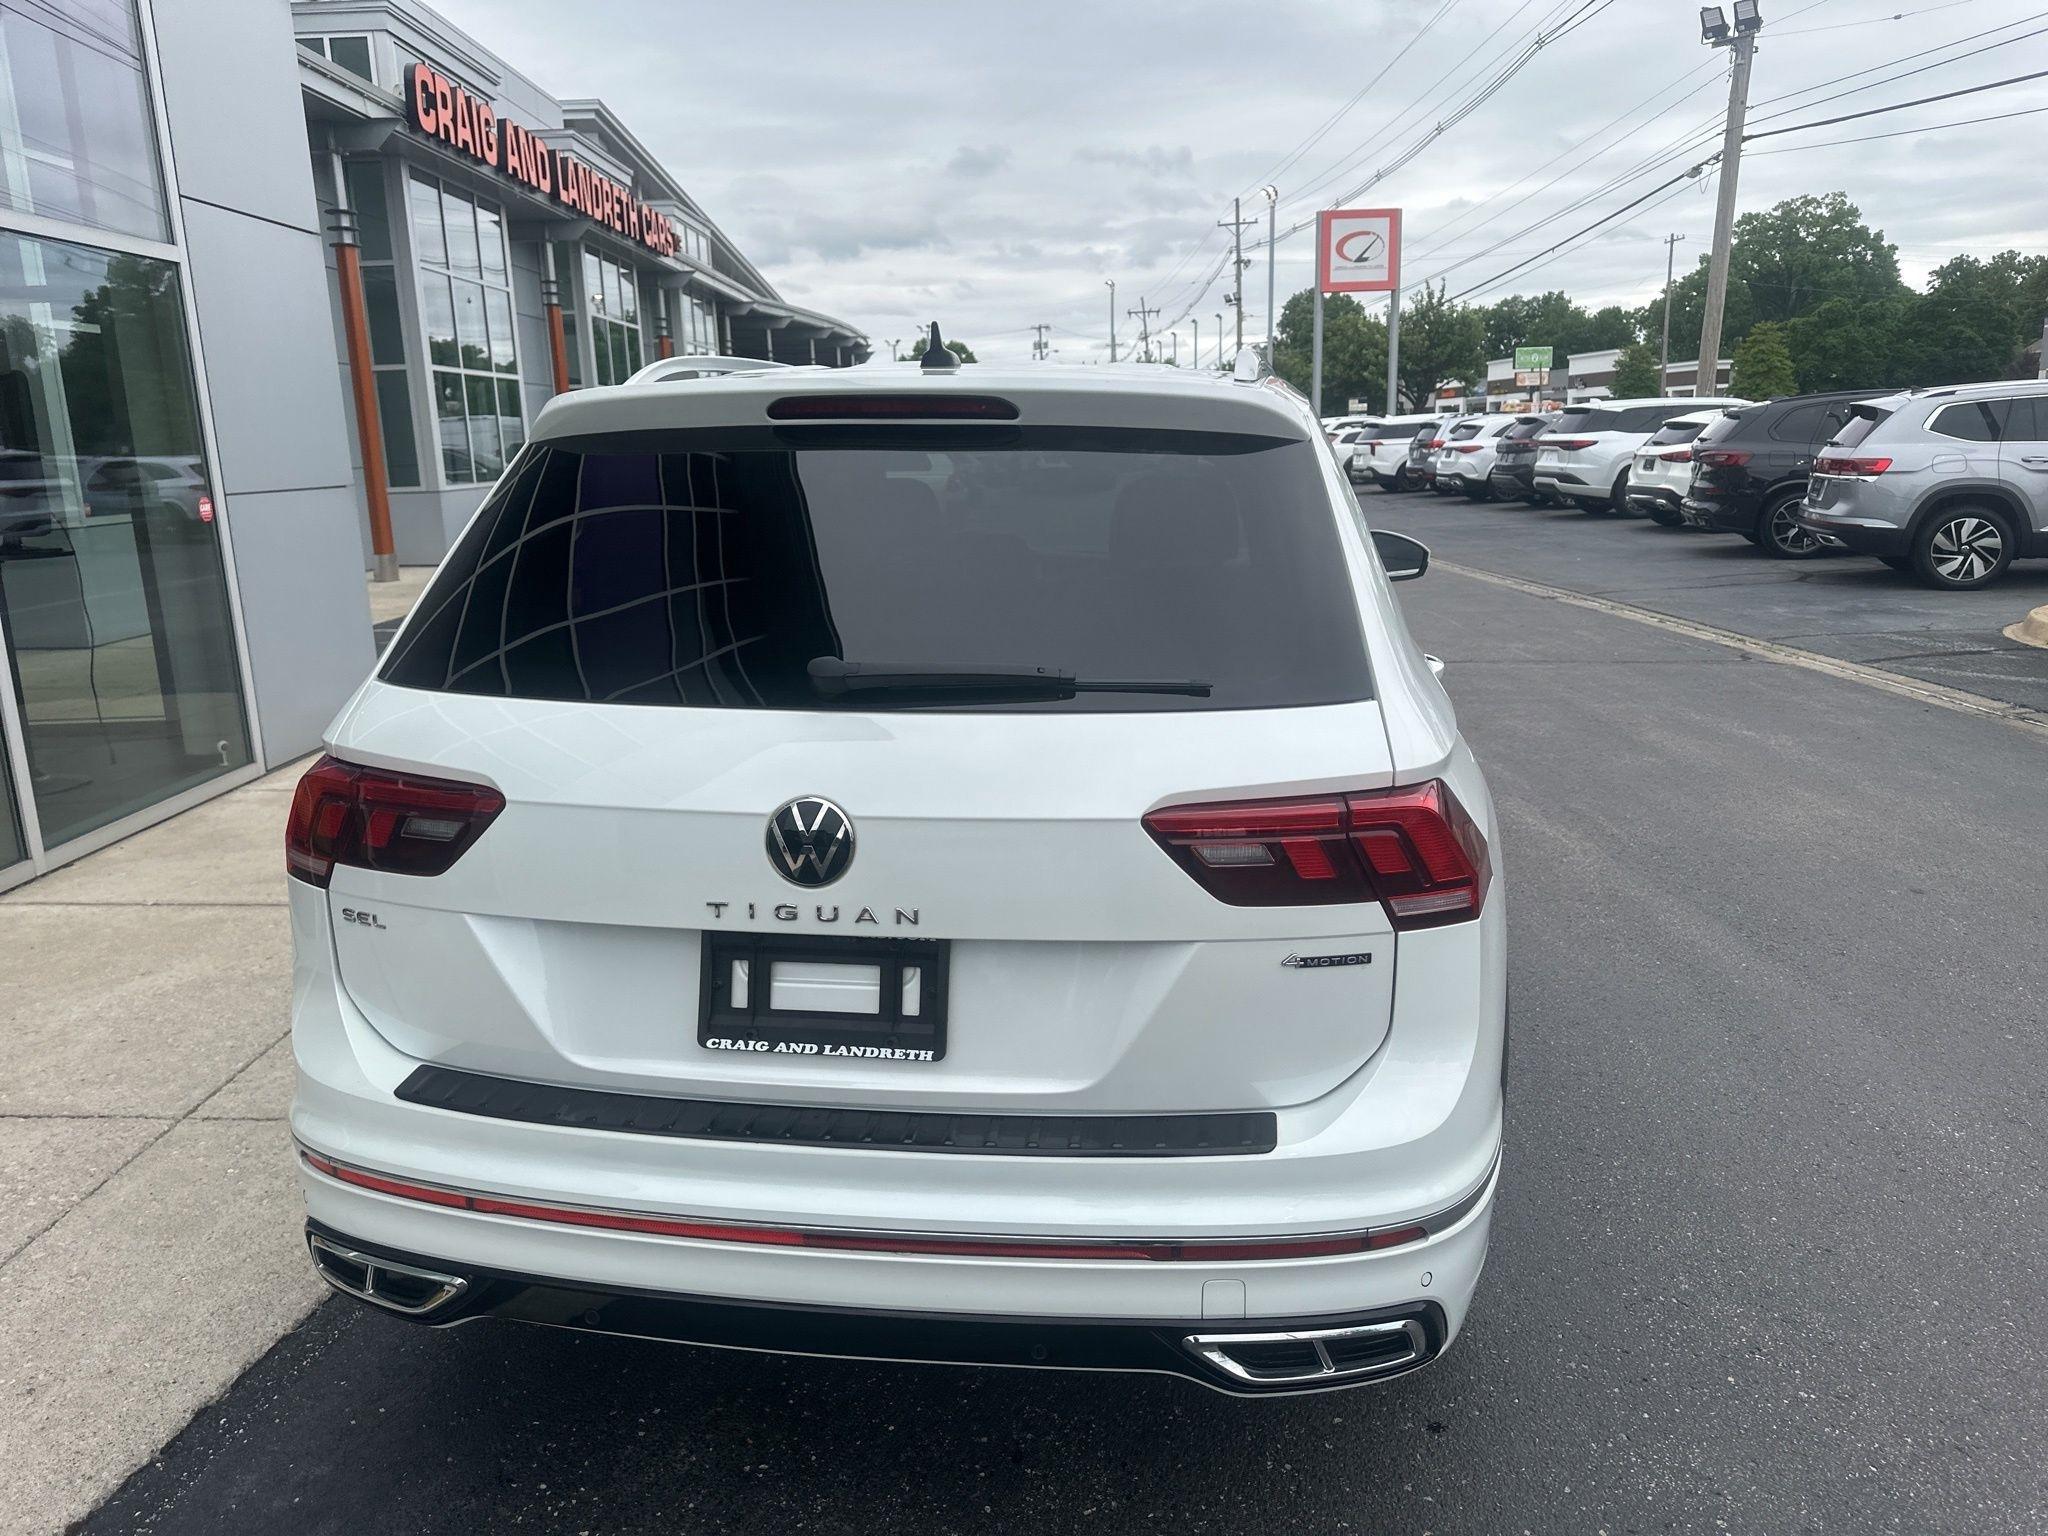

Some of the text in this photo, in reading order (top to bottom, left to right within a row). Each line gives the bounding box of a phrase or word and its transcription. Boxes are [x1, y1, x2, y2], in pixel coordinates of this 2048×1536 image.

[410, 62, 675, 257] CRAIG AND LANDRETH CARS
[342, 907, 387, 930] SEL
[705, 901, 920, 925] TIGUAN
[706, 1037, 935, 1061] CRAIG AND LANDRETH
